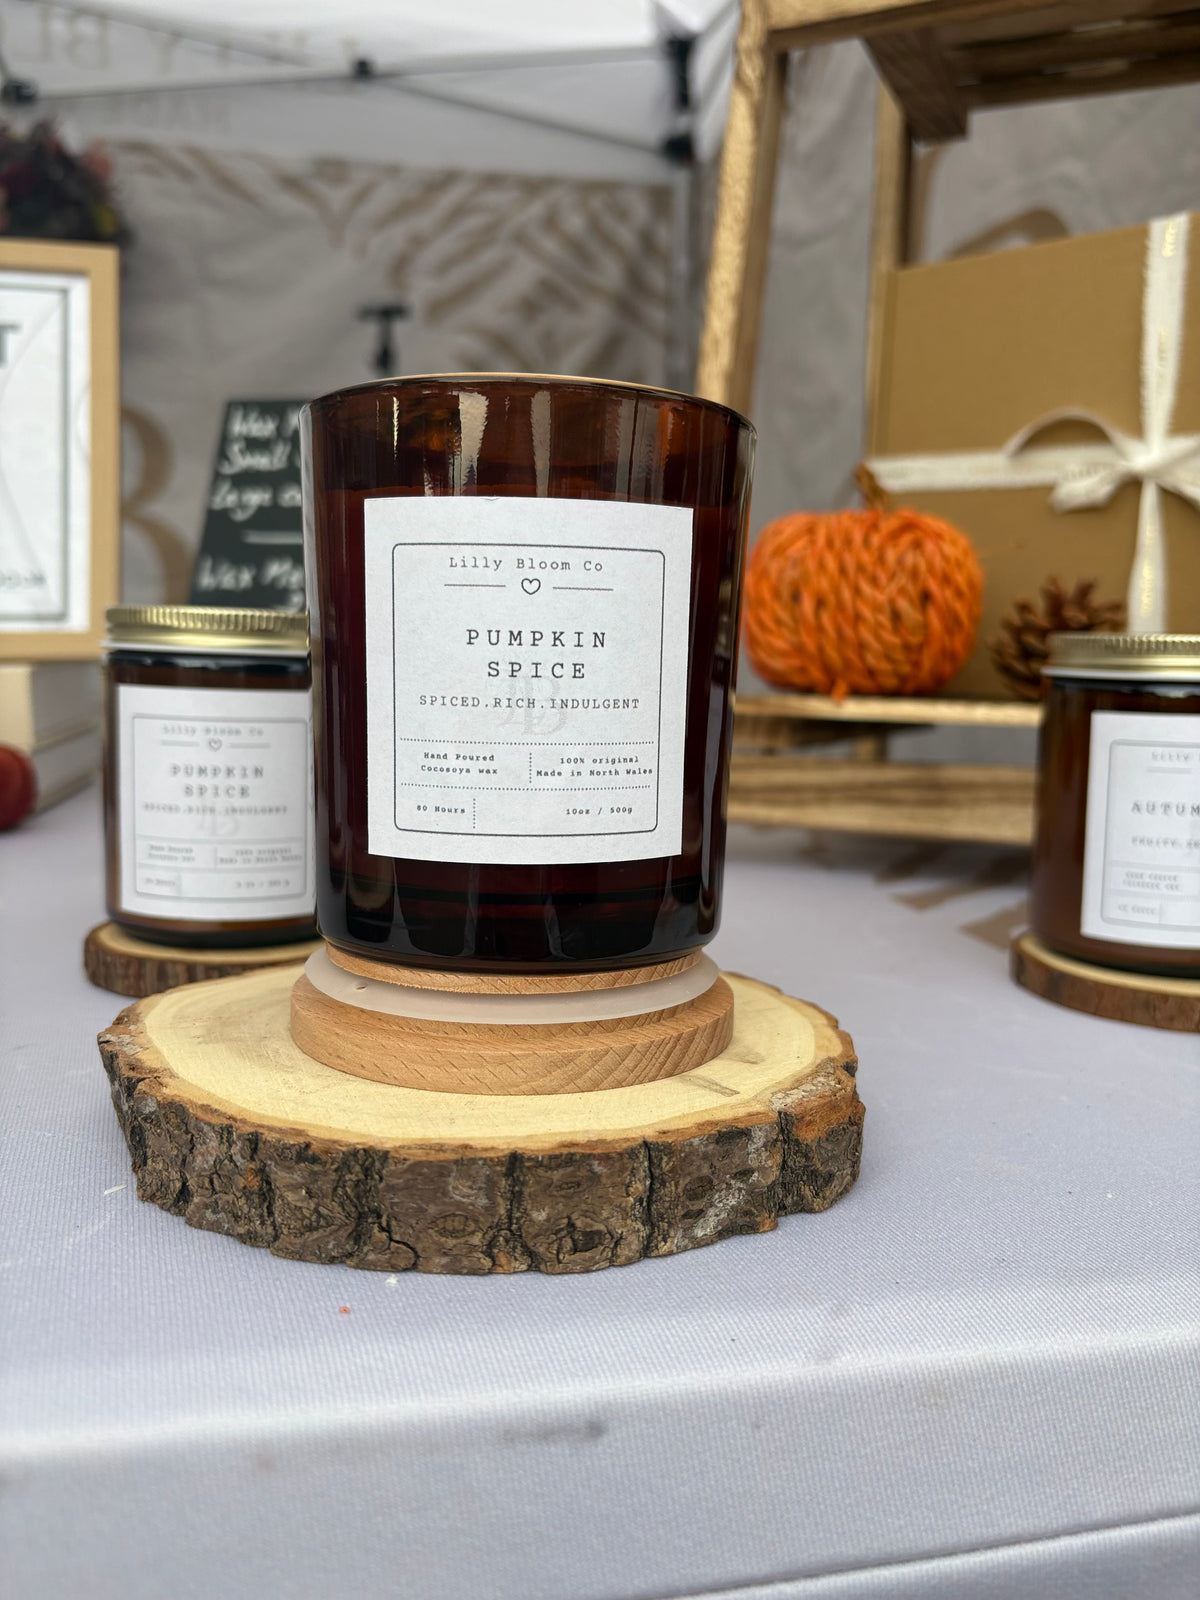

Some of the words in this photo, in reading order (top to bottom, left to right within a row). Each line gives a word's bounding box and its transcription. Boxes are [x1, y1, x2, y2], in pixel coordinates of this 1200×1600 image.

[449, 555, 503, 572] Lilly
[515, 557, 571, 571] Bloom
[583, 560, 603, 572] Co
[465, 628, 606, 649] PUMPKIN
[487, 660, 585, 680] SPICE
[423, 751, 449, 761] Hand
[455, 753, 495, 762] Poured
[560, 756, 585, 765] 100%
[591, 755, 639, 766] original
[170, 763, 264, 779] PUMPKIN
[420, 764, 471, 775] Cocosoya
[477, 767, 498, 775] wax
[535, 768, 563, 777] Made
[570, 769, 583, 777] in
[589, 768, 620, 777] North
[625, 767, 653, 776] Wales
[183, 784, 250, 798] SPICE
[434, 805, 466, 815] Hours
[565, 807, 591, 816] 10oz
[609, 806, 633, 815] 500g
